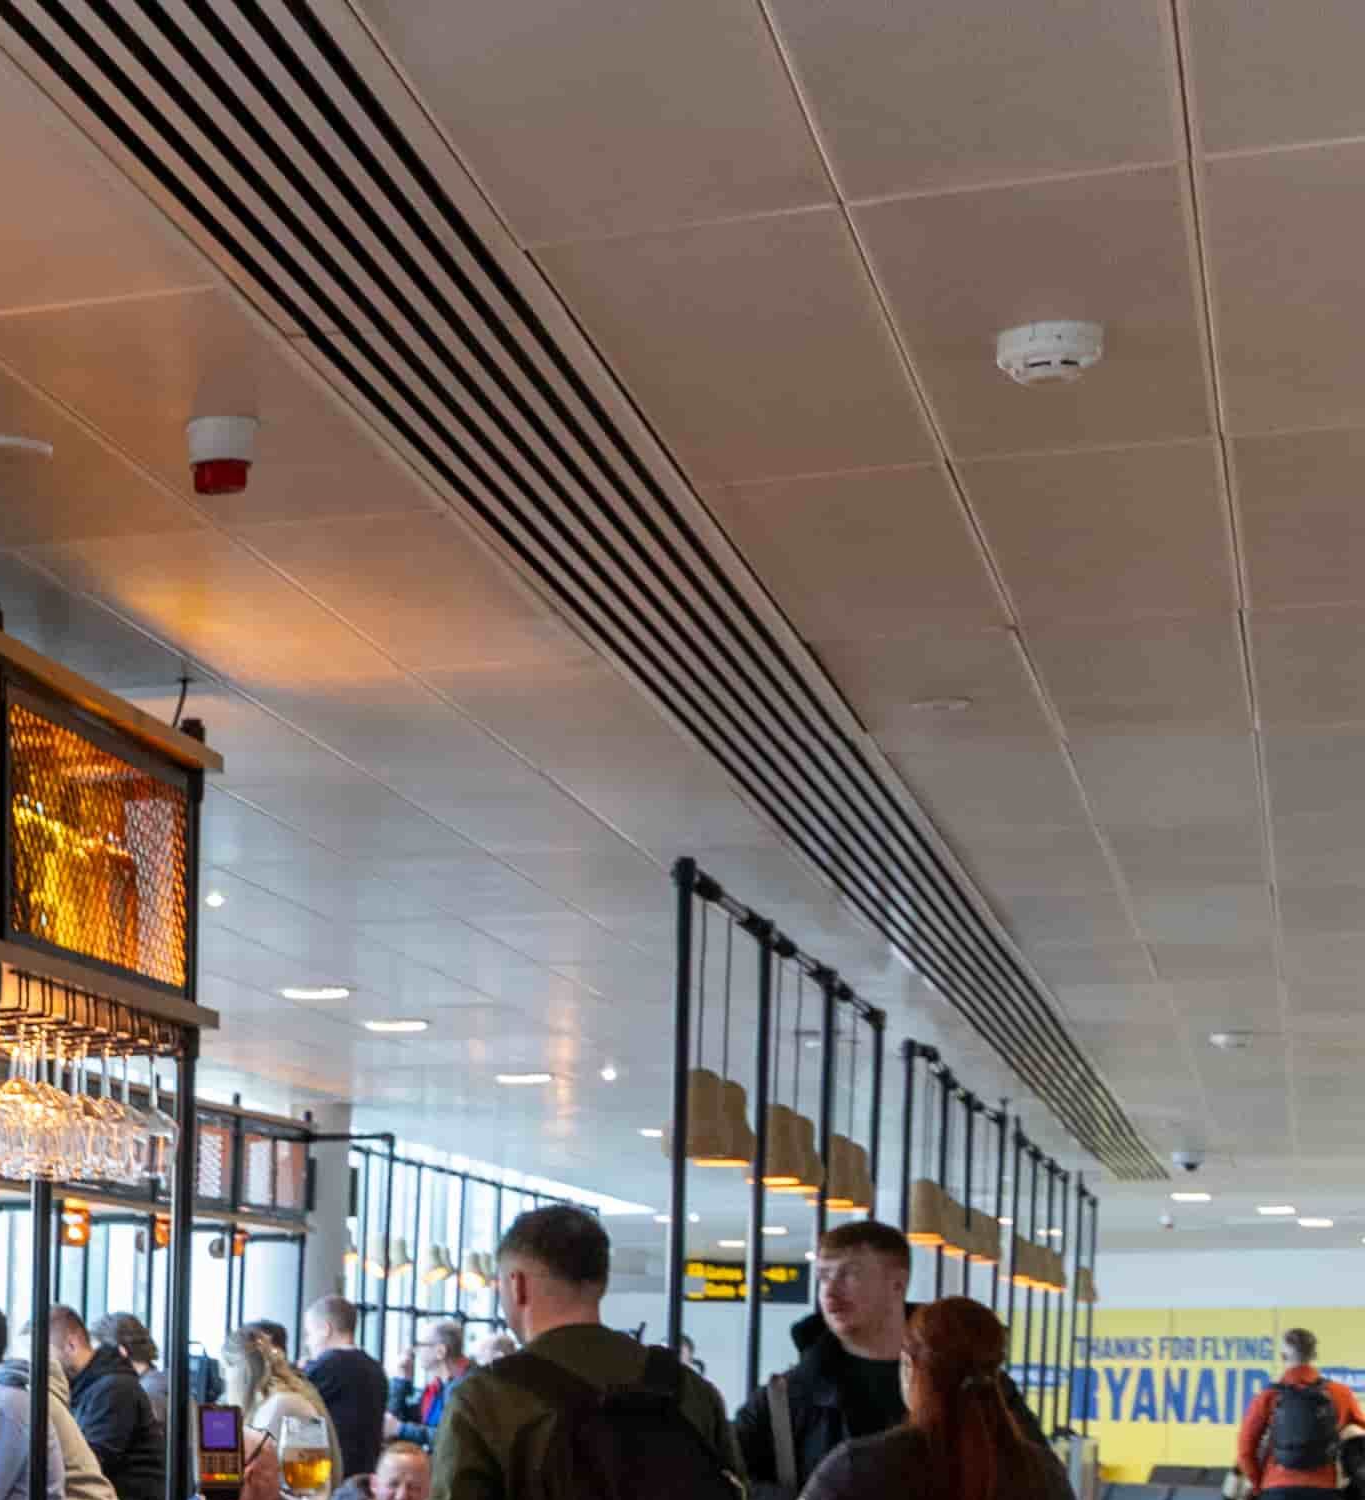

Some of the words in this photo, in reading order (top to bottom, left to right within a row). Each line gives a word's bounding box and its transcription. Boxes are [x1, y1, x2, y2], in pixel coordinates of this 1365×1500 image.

[1076, 1336, 1154, 1360] THANKS
[1158, 1336, 1196, 1360] FOR
[1200, 1336, 1274, 1361] FLYING
